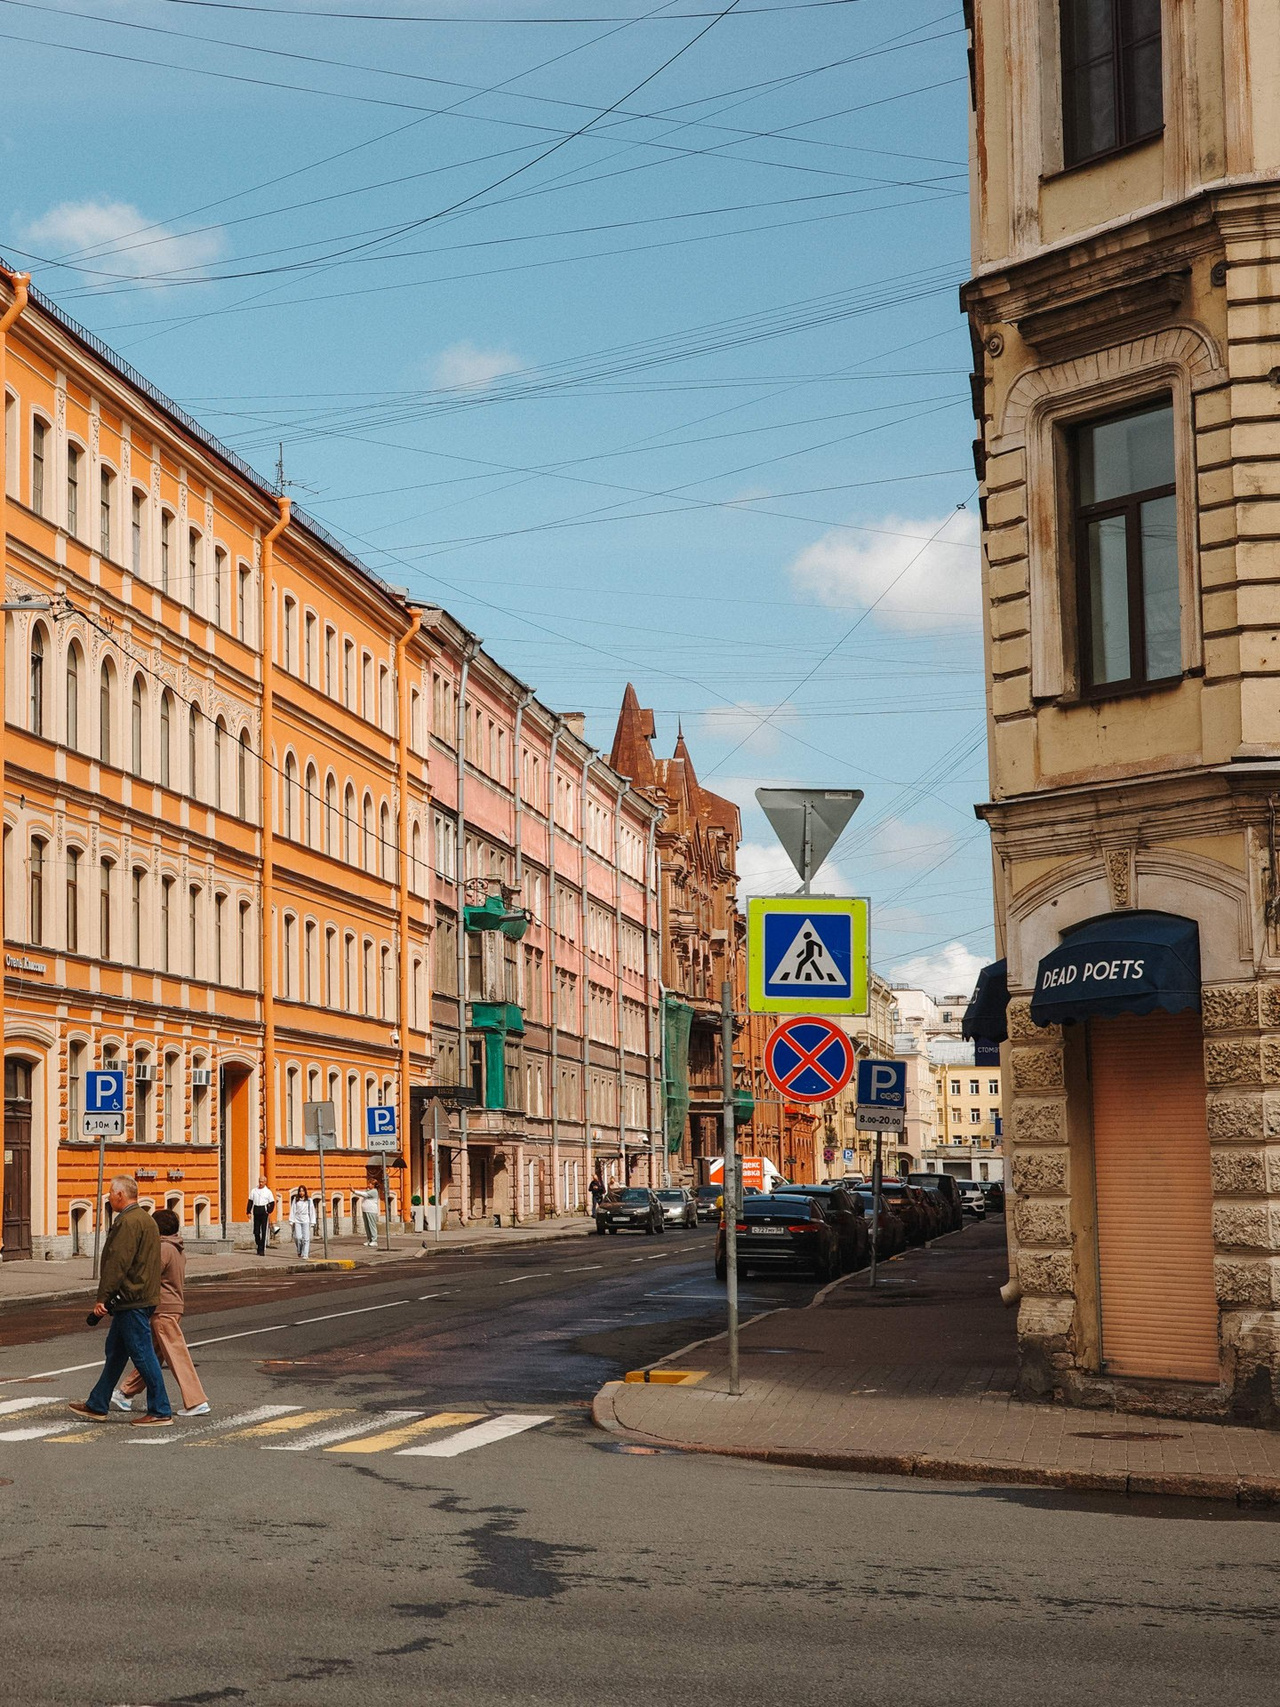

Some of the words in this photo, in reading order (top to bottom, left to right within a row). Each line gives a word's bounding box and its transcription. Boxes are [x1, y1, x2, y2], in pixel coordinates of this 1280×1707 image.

[1042, 965, 1078, 990] DEAD
[1082, 960, 1145, 982] POETS
[96, 1075, 117, 1108] P
[870, 1065, 897, 1101] P
[374, 1109, 391, 1133] P
[859, 1114, 900, 1126] 8.00-20.00
[742, 1161, 761, 1169] декс
